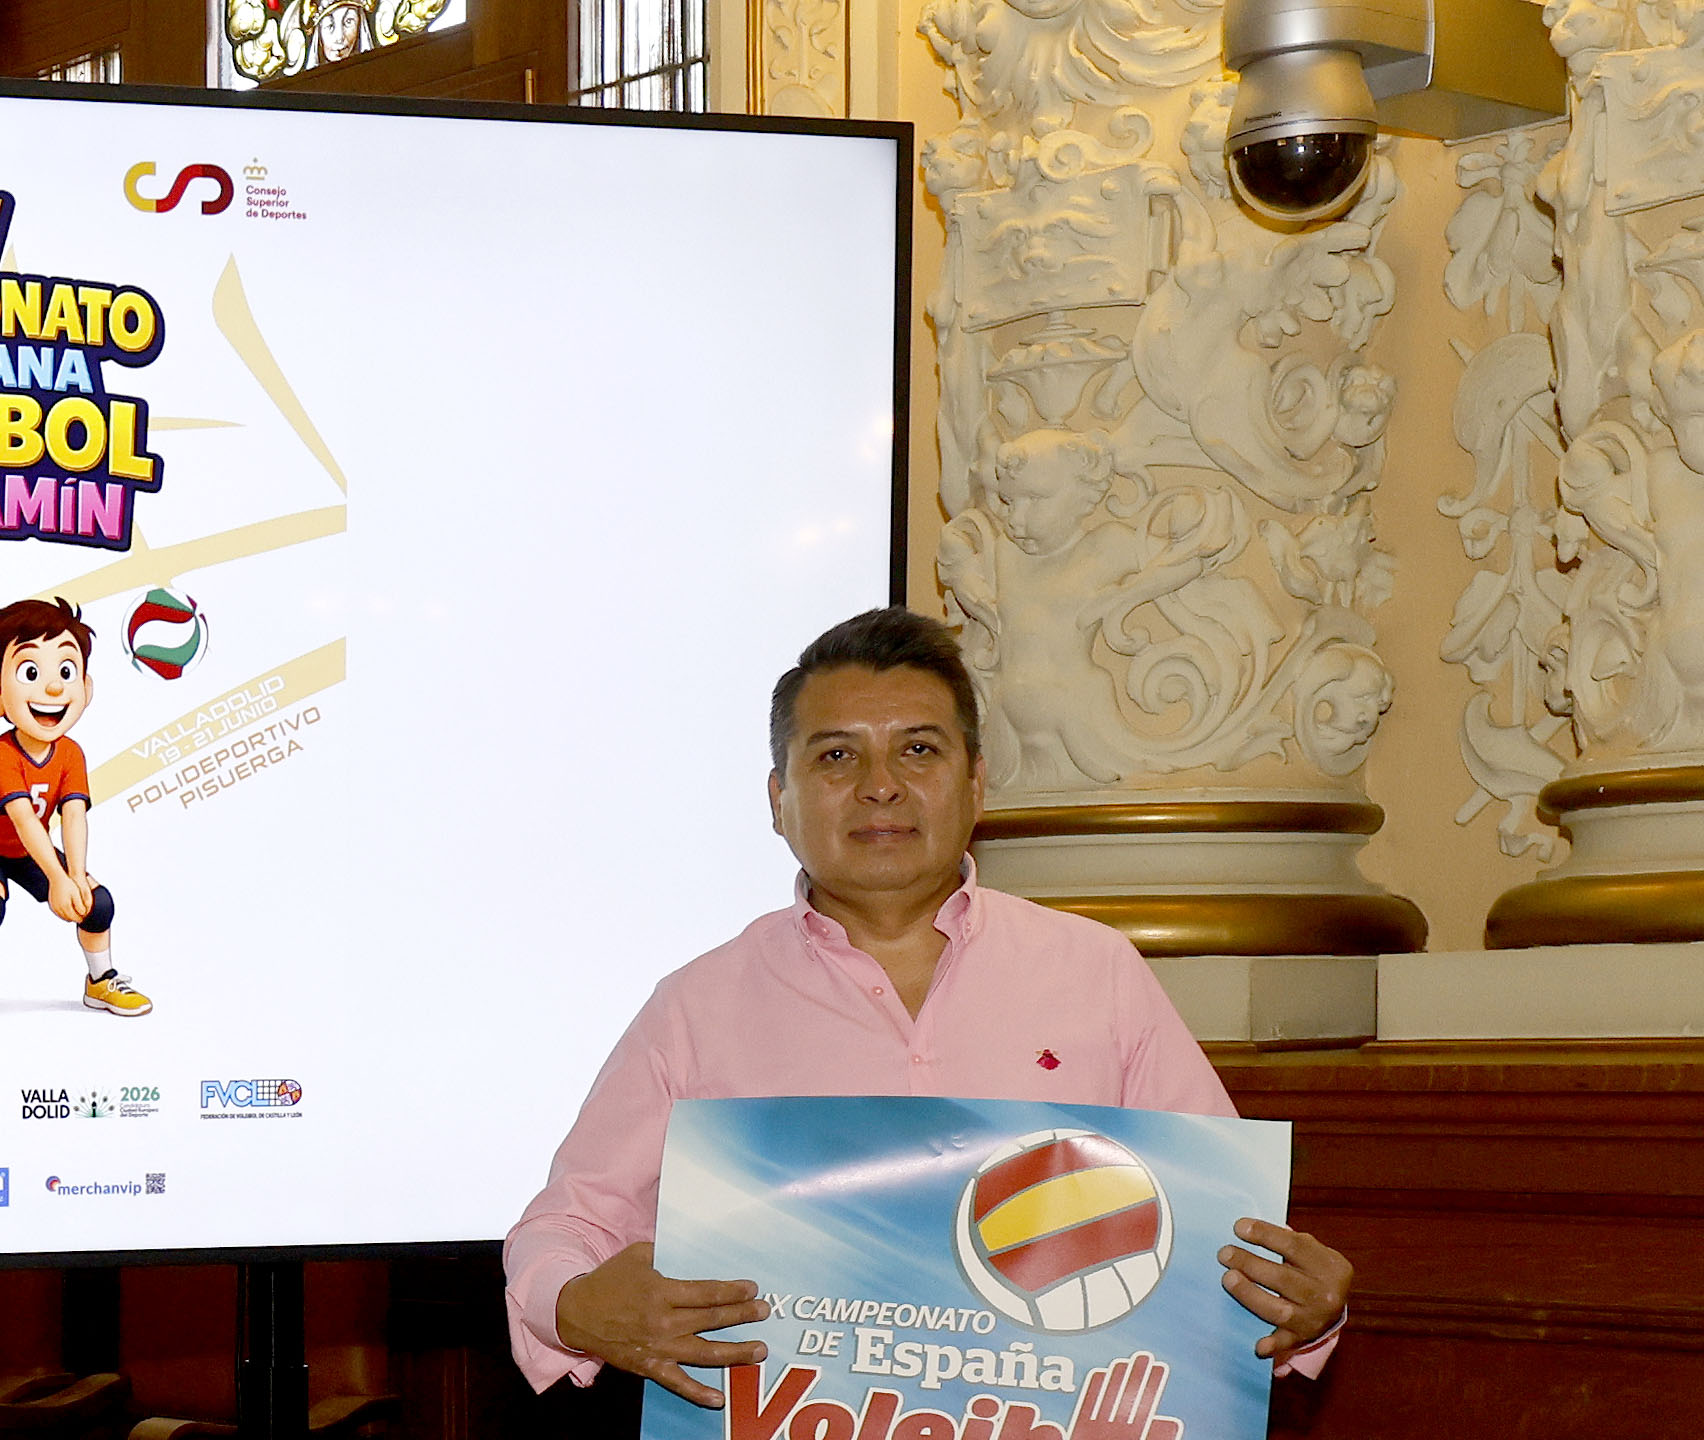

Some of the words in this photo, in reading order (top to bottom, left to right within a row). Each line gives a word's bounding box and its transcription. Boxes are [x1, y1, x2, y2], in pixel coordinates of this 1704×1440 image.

[246, 185, 286, 199] Consejo
[246, 197, 289, 208] Superior
[246, 209, 258, 217] de
[262, 210, 307, 221] Deportes
[132, 674, 286, 759] VALLADOLID
[217, 696, 278, 736] JUNIO
[126, 706, 322, 813] POLIDEPORTIVO
[179, 739, 304, 810] PISUERGA
[31, 783, 50, 818] 5
[21, 1088, 70, 1103] VALLA
[120, 1086, 161, 1101] 2026
[22, 1104, 71, 1119] DOLID
[58, 1181, 142, 1196] merchanvip
[795, 1295, 995, 1334] CAMPEONATO
[799, 1329, 844, 1356] DE
[851, 1328, 1076, 1392] España
